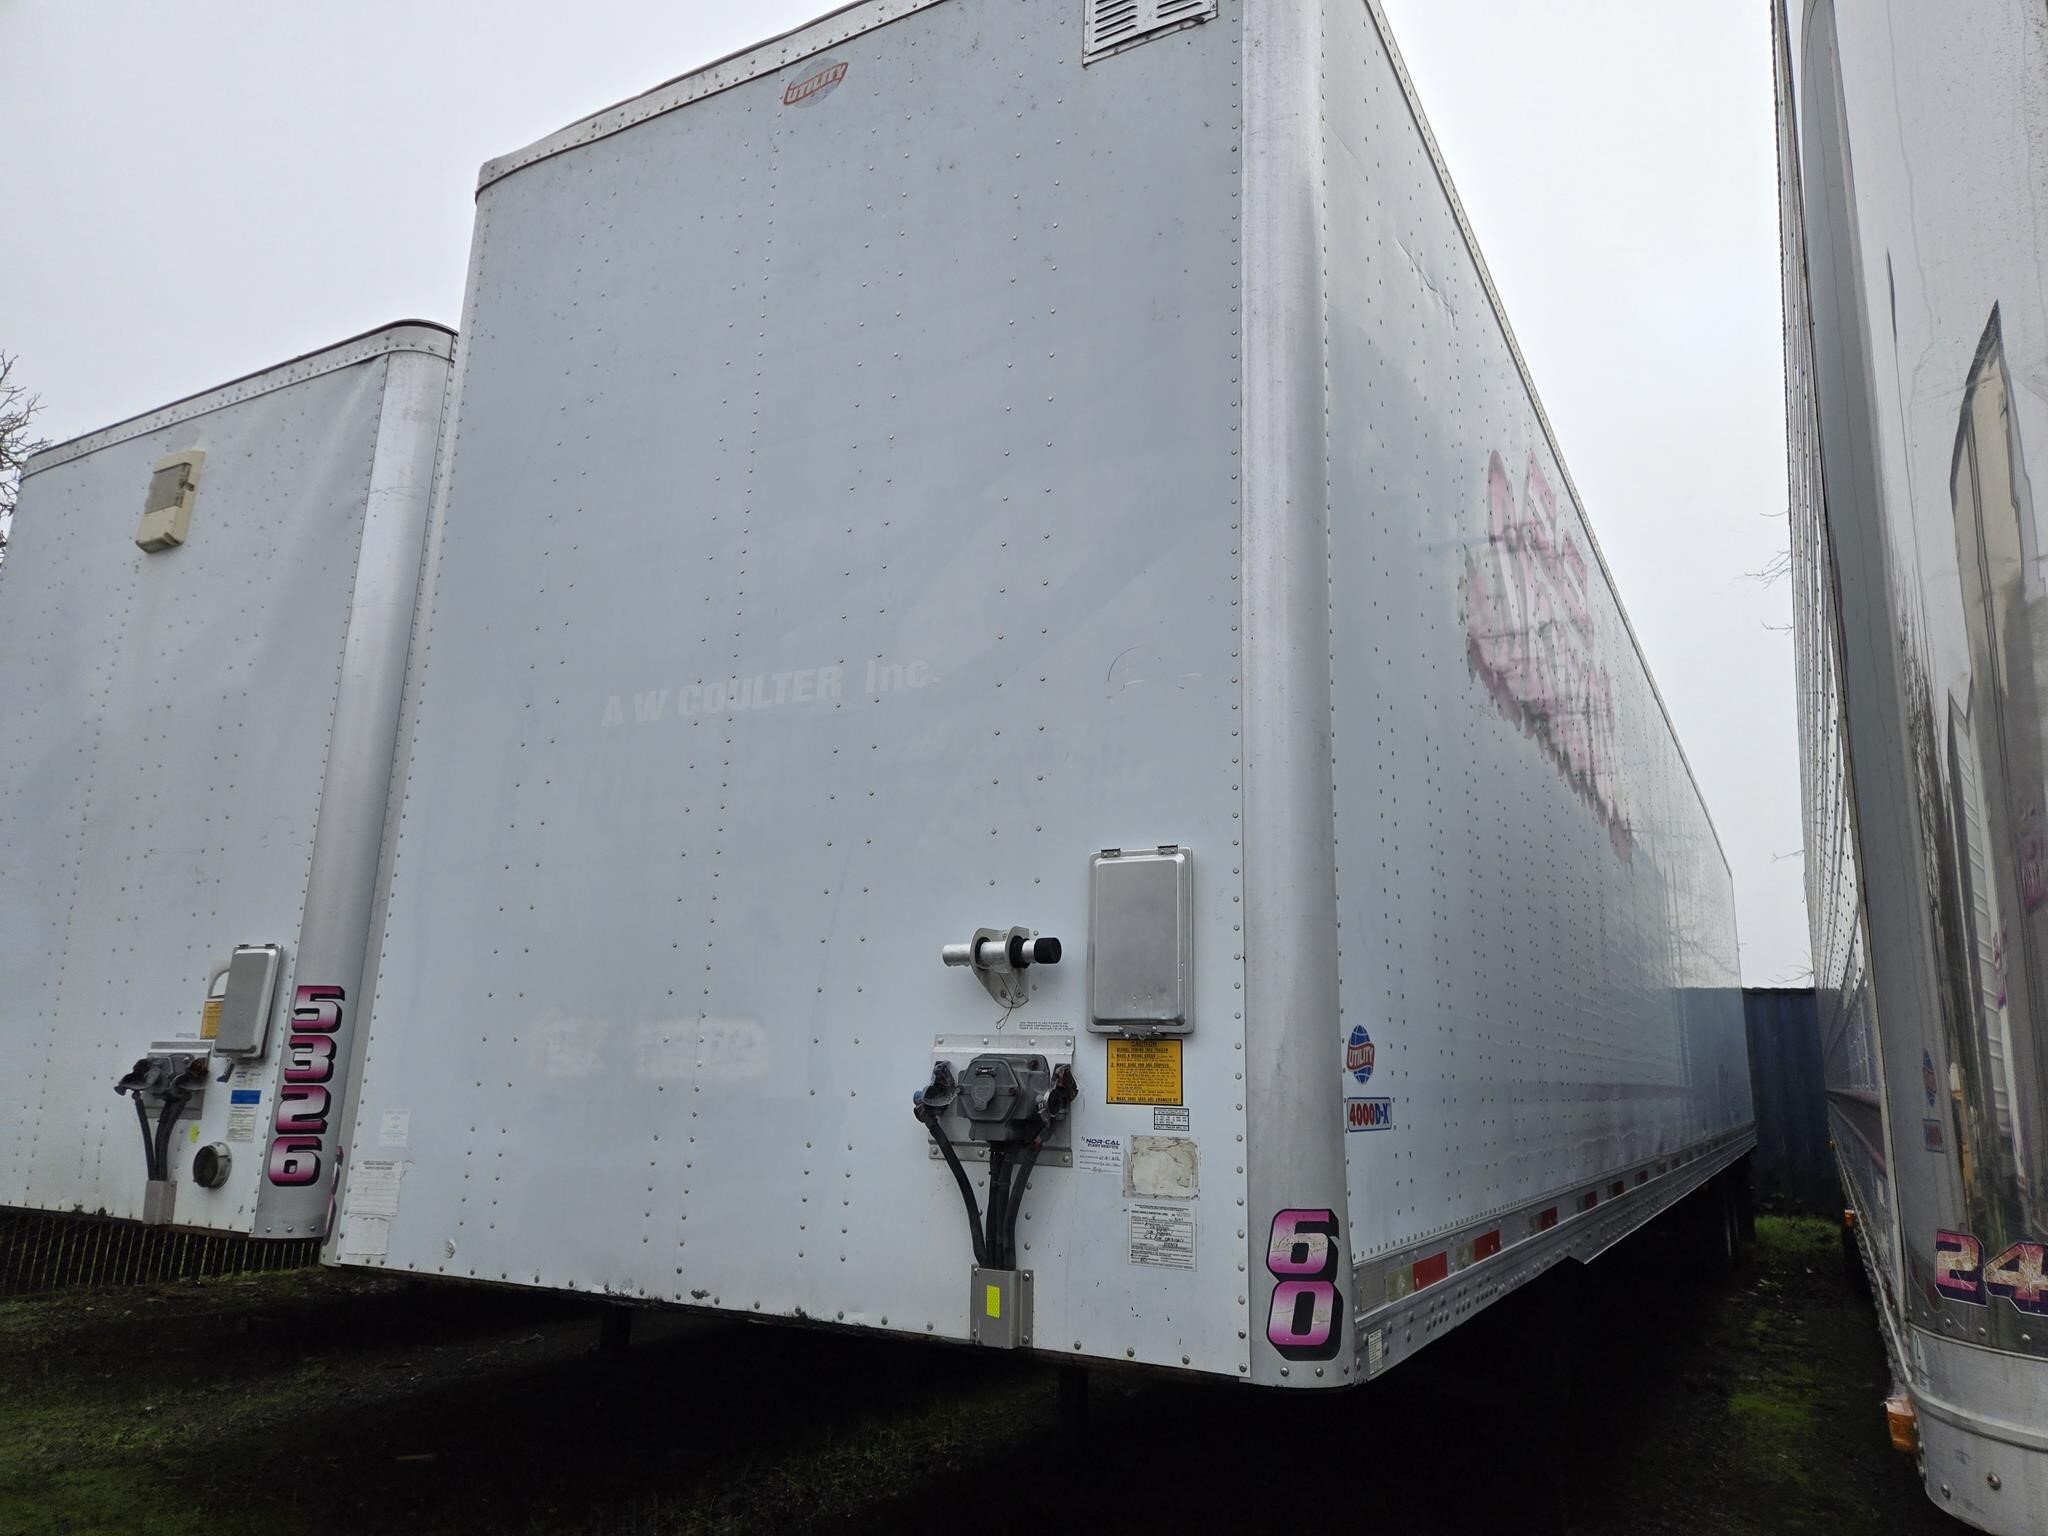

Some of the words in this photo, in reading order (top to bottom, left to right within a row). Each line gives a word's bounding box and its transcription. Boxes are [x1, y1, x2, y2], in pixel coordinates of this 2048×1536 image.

[785, 62, 847, 105] UTILITY
[601, 695, 623, 728] A
[633, 688, 669, 723] W
[677, 665, 844, 718] COULTER
[1349, 1046, 1374, 1067] UTILITY
[267, 984, 346, 1187] 5326
[1349, 1102, 1390, 1127] 4000D-X
[1265, 1207, 1344, 1362] 60
